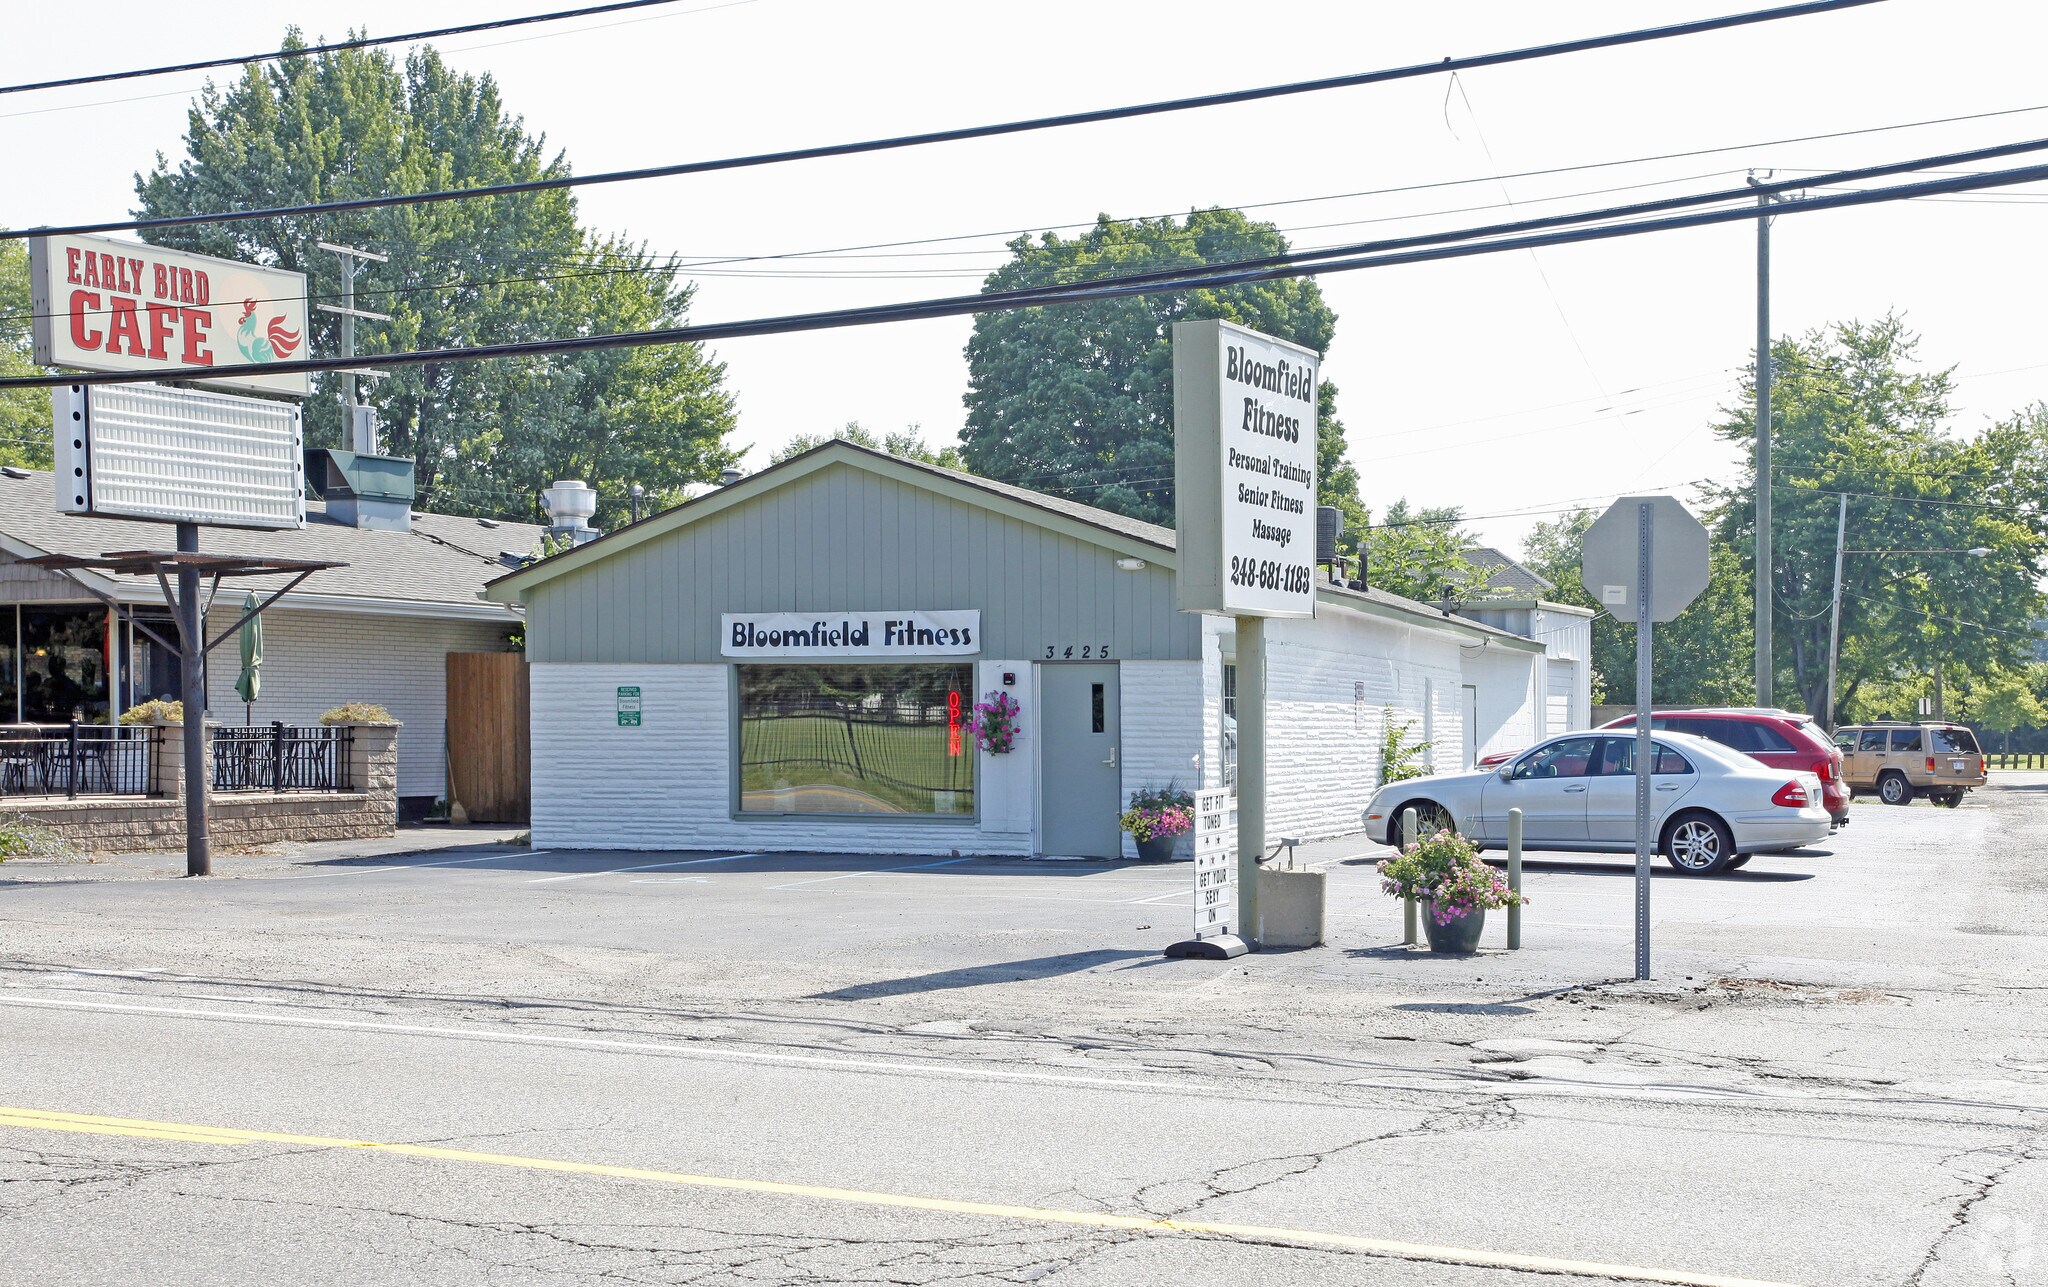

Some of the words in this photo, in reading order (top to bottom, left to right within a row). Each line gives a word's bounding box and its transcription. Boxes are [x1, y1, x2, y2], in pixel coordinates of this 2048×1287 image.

[66, 247, 145, 295] EARLY
[153, 262, 210, 306] BIRD
[69, 289, 213, 367] CAFE
[1226, 345, 1312, 403] Bloomfield
[1242, 397, 1299, 444] Fitness
[1228, 447, 1271, 476] Personal
[1272, 458, 1312, 490] Training
[1238, 482, 1269, 508] Senior
[1271, 490, 1304, 515] Fitness
[1252, 518, 1292, 548] Massage
[1230, 555, 1311, 595] 248-681-1183
[732, 621, 869, 647] Bloomfield
[884, 620, 972, 646] Fitness
[1045, 645, 1109, 659] 3425
[948, 691, 962, 757] OPEN
[1202, 797, 1213, 812] GET
[1215, 794, 1225, 809] FIT
[1200, 873, 1211, 888] GET
[1213, 868, 1227, 885] YOUR
[1206, 888, 1220, 906] SEXY
[1208, 908, 1217, 923] ON
